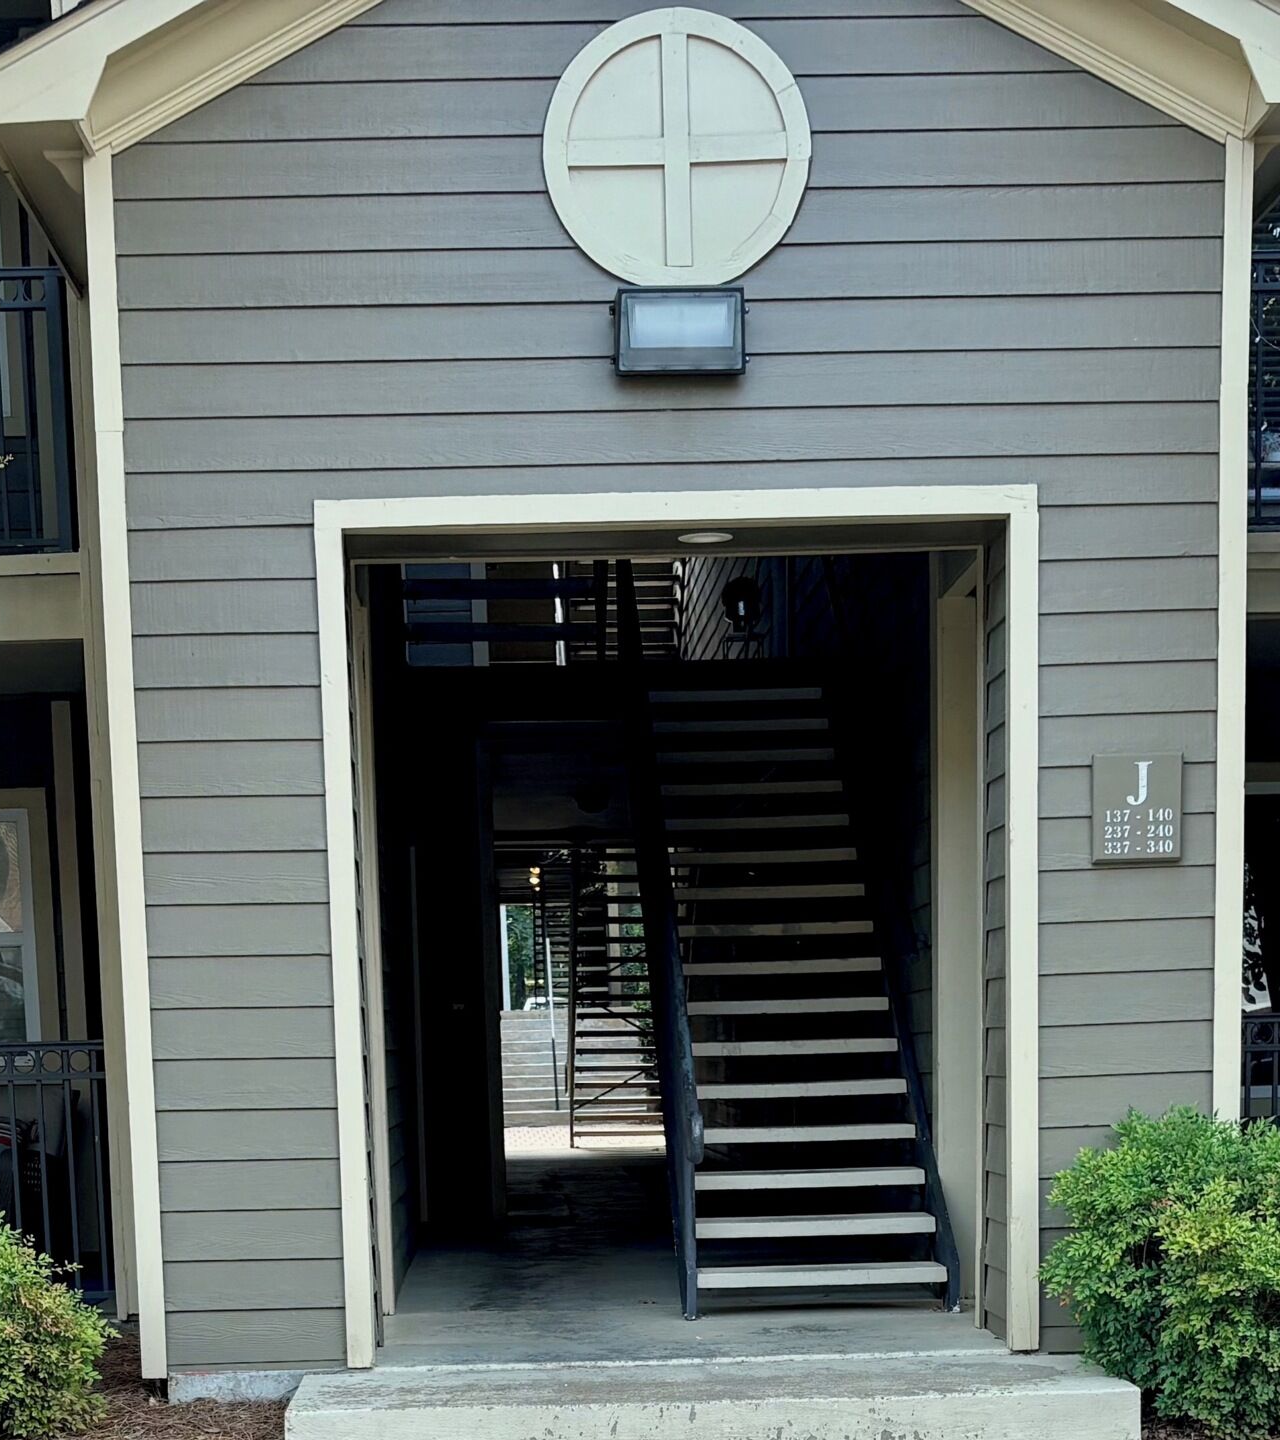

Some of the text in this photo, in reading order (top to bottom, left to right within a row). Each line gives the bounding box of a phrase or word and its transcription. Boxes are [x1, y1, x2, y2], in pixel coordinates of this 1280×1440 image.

[1126, 761, 1153, 805] J
[1105, 810, 1130, 822] 137
[1148, 809, 1173, 821] 140
[1105, 826, 1130, 838] 237
[1147, 825, 1173, 837] 240
[1105, 842, 1130, 854] 337
[1147, 840, 1173, 853] 340
